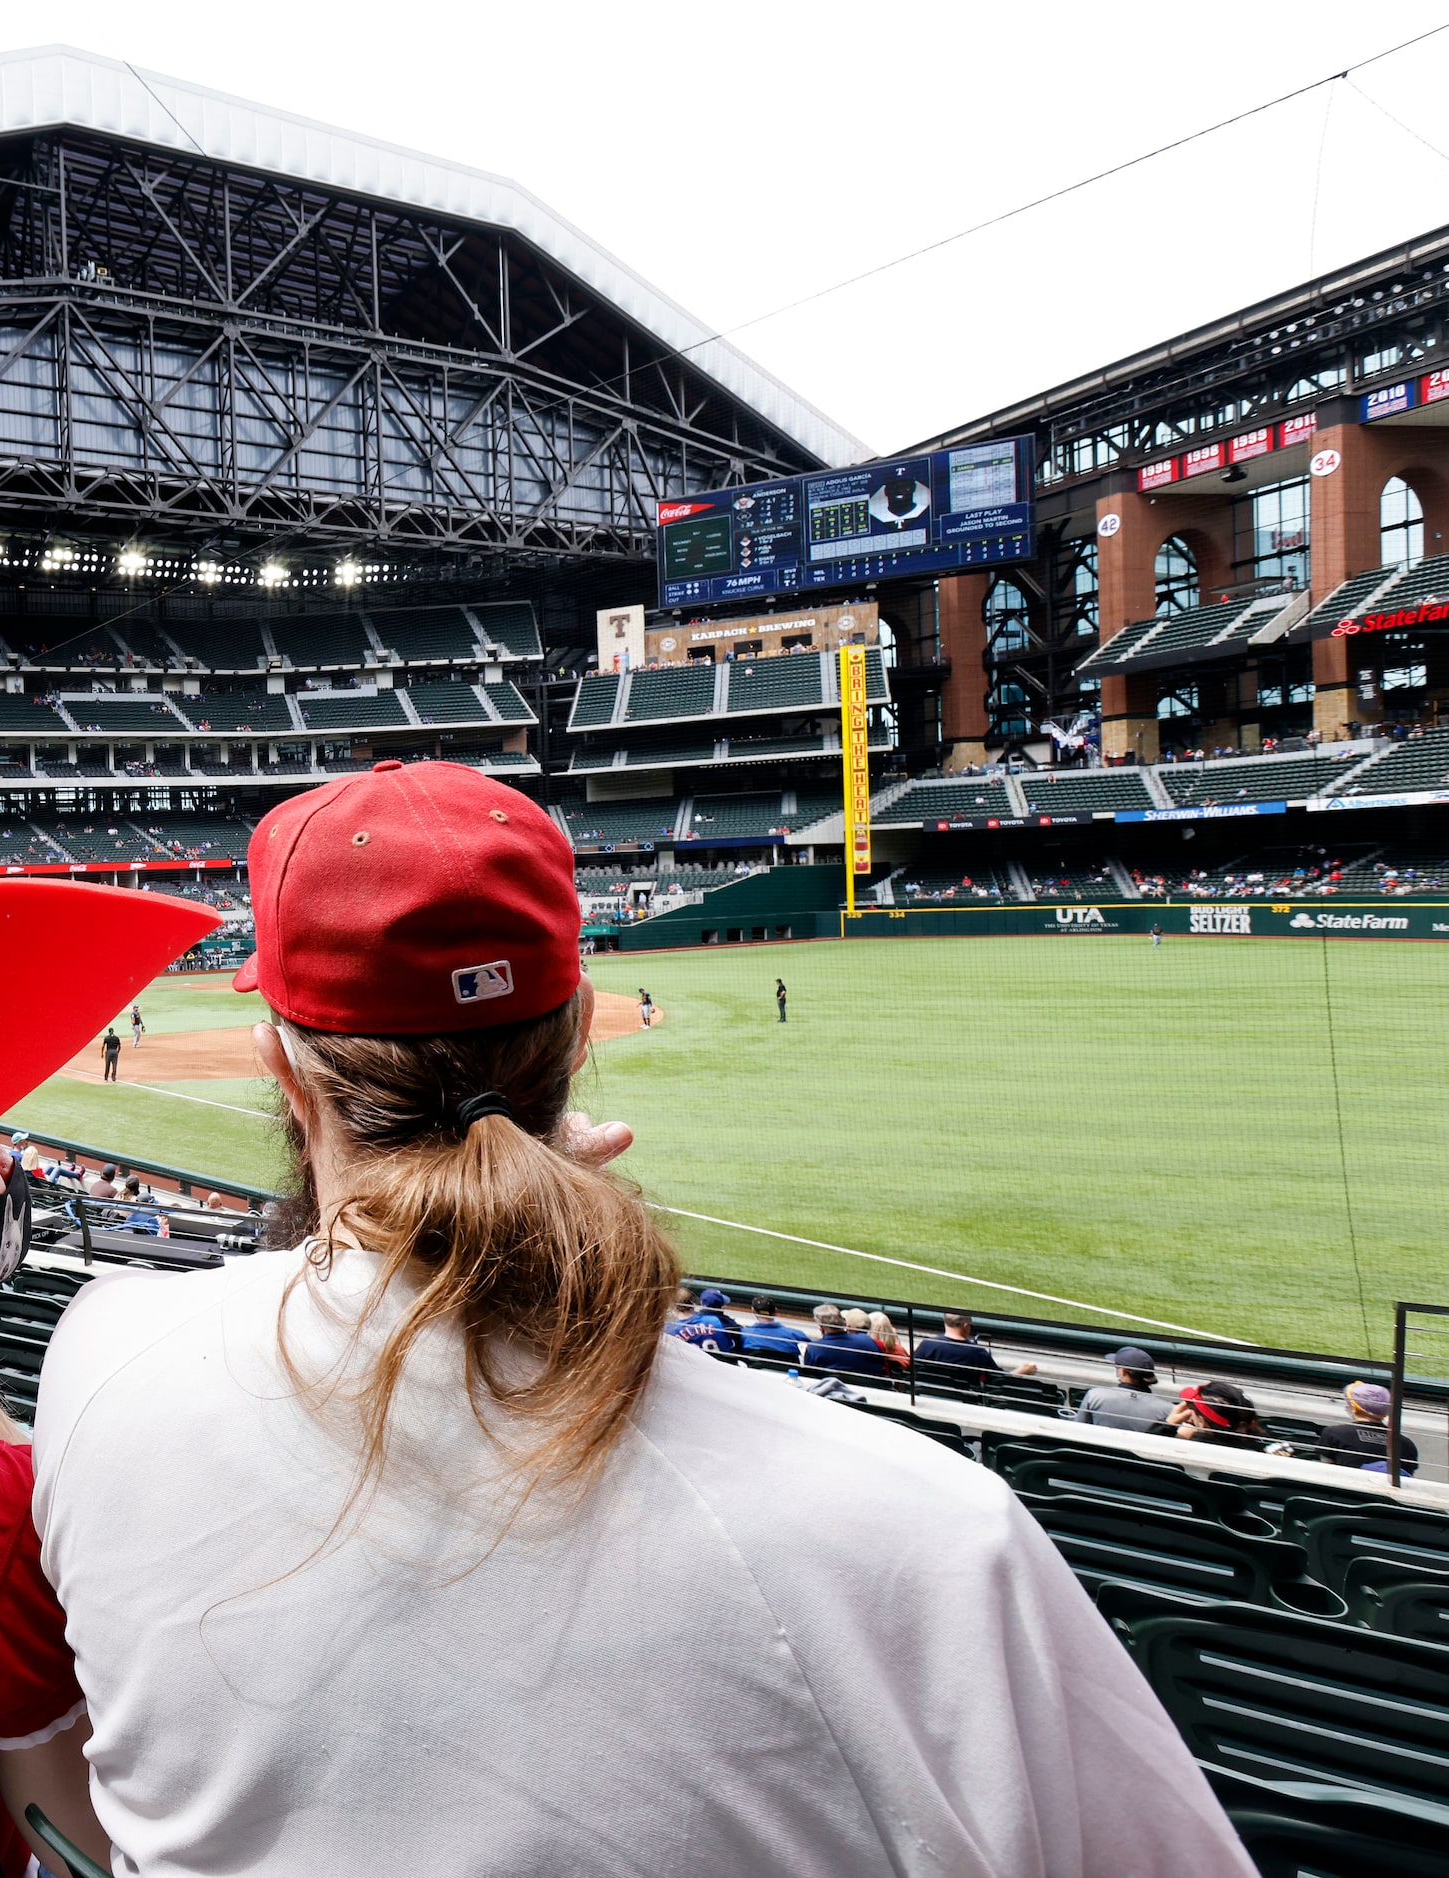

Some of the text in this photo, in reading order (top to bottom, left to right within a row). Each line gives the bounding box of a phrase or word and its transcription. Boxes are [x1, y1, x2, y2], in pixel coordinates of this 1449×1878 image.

[1367, 384, 1406, 407] 2010
[1232, 428, 1268, 450] 1999
[1186, 444, 1220, 465] 1998
[1315, 453, 1335, 471] 34
[1141, 460, 1172, 479] 1996
[752, 488, 787, 498] ANDERSON
[960, 514, 1009, 527] JASON MARTIN
[965, 508, 1003, 520] LAST PLAY
[946, 524, 984, 535] GROUNDED
[995, 517, 1023, 527] SECOND
[1101, 518, 1117, 532] 42
[722, 584, 765, 595] KNUCKLE CURVE
[726, 575, 762, 588] 76 MPH
[609, 613, 630, 638] T
[757, 618, 816, 633] BREWING
[852, 665, 862, 727] BRING
[854, 731, 863, 769] THE
[855, 774, 865, 822] HEAT
[1055, 908, 1106, 924] UTA
[1190, 906, 1250, 914] BUD LIGHT
[1190, 914, 1251, 934] SELTZER
